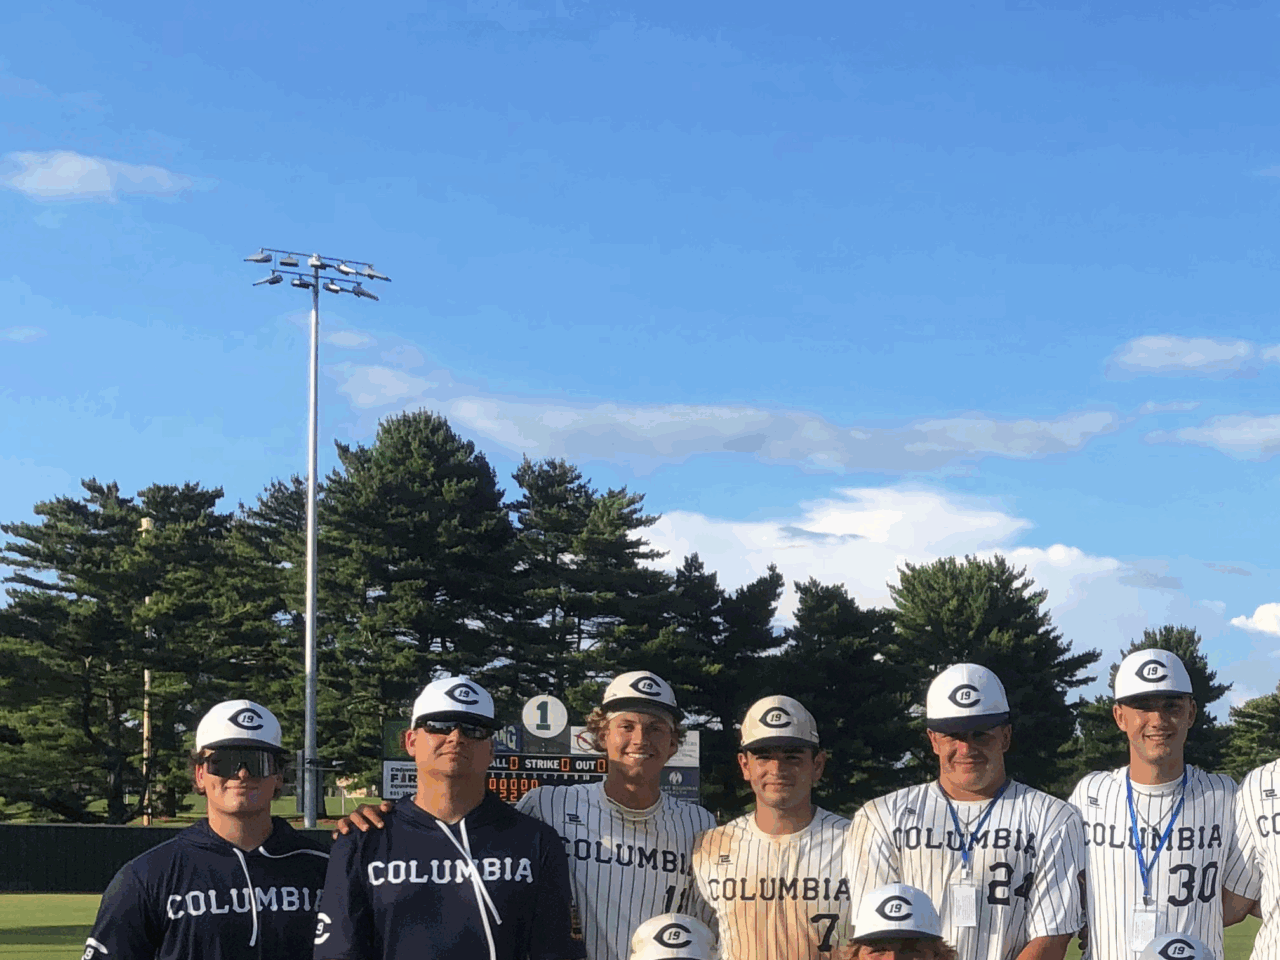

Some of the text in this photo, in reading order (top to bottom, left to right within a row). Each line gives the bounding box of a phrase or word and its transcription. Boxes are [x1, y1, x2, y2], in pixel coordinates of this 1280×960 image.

[536, 700, 551, 731] 1
[490, 758, 508, 768] ALL
[525, 758, 560, 769] STRIKE
[575, 760, 596, 770] OUT
[892, 826, 1037, 859] COLUMBIA
[1082, 821, 1223, 852] COLUMBIA
[367, 857, 534, 886] COLUMBIA
[986, 861, 1035, 906] 24
[1167, 860, 1219, 907] 30
[166, 886, 323, 920] COLUMBI
[707, 877, 851, 901] COLUMBIA
[810, 913, 840, 953] 7
